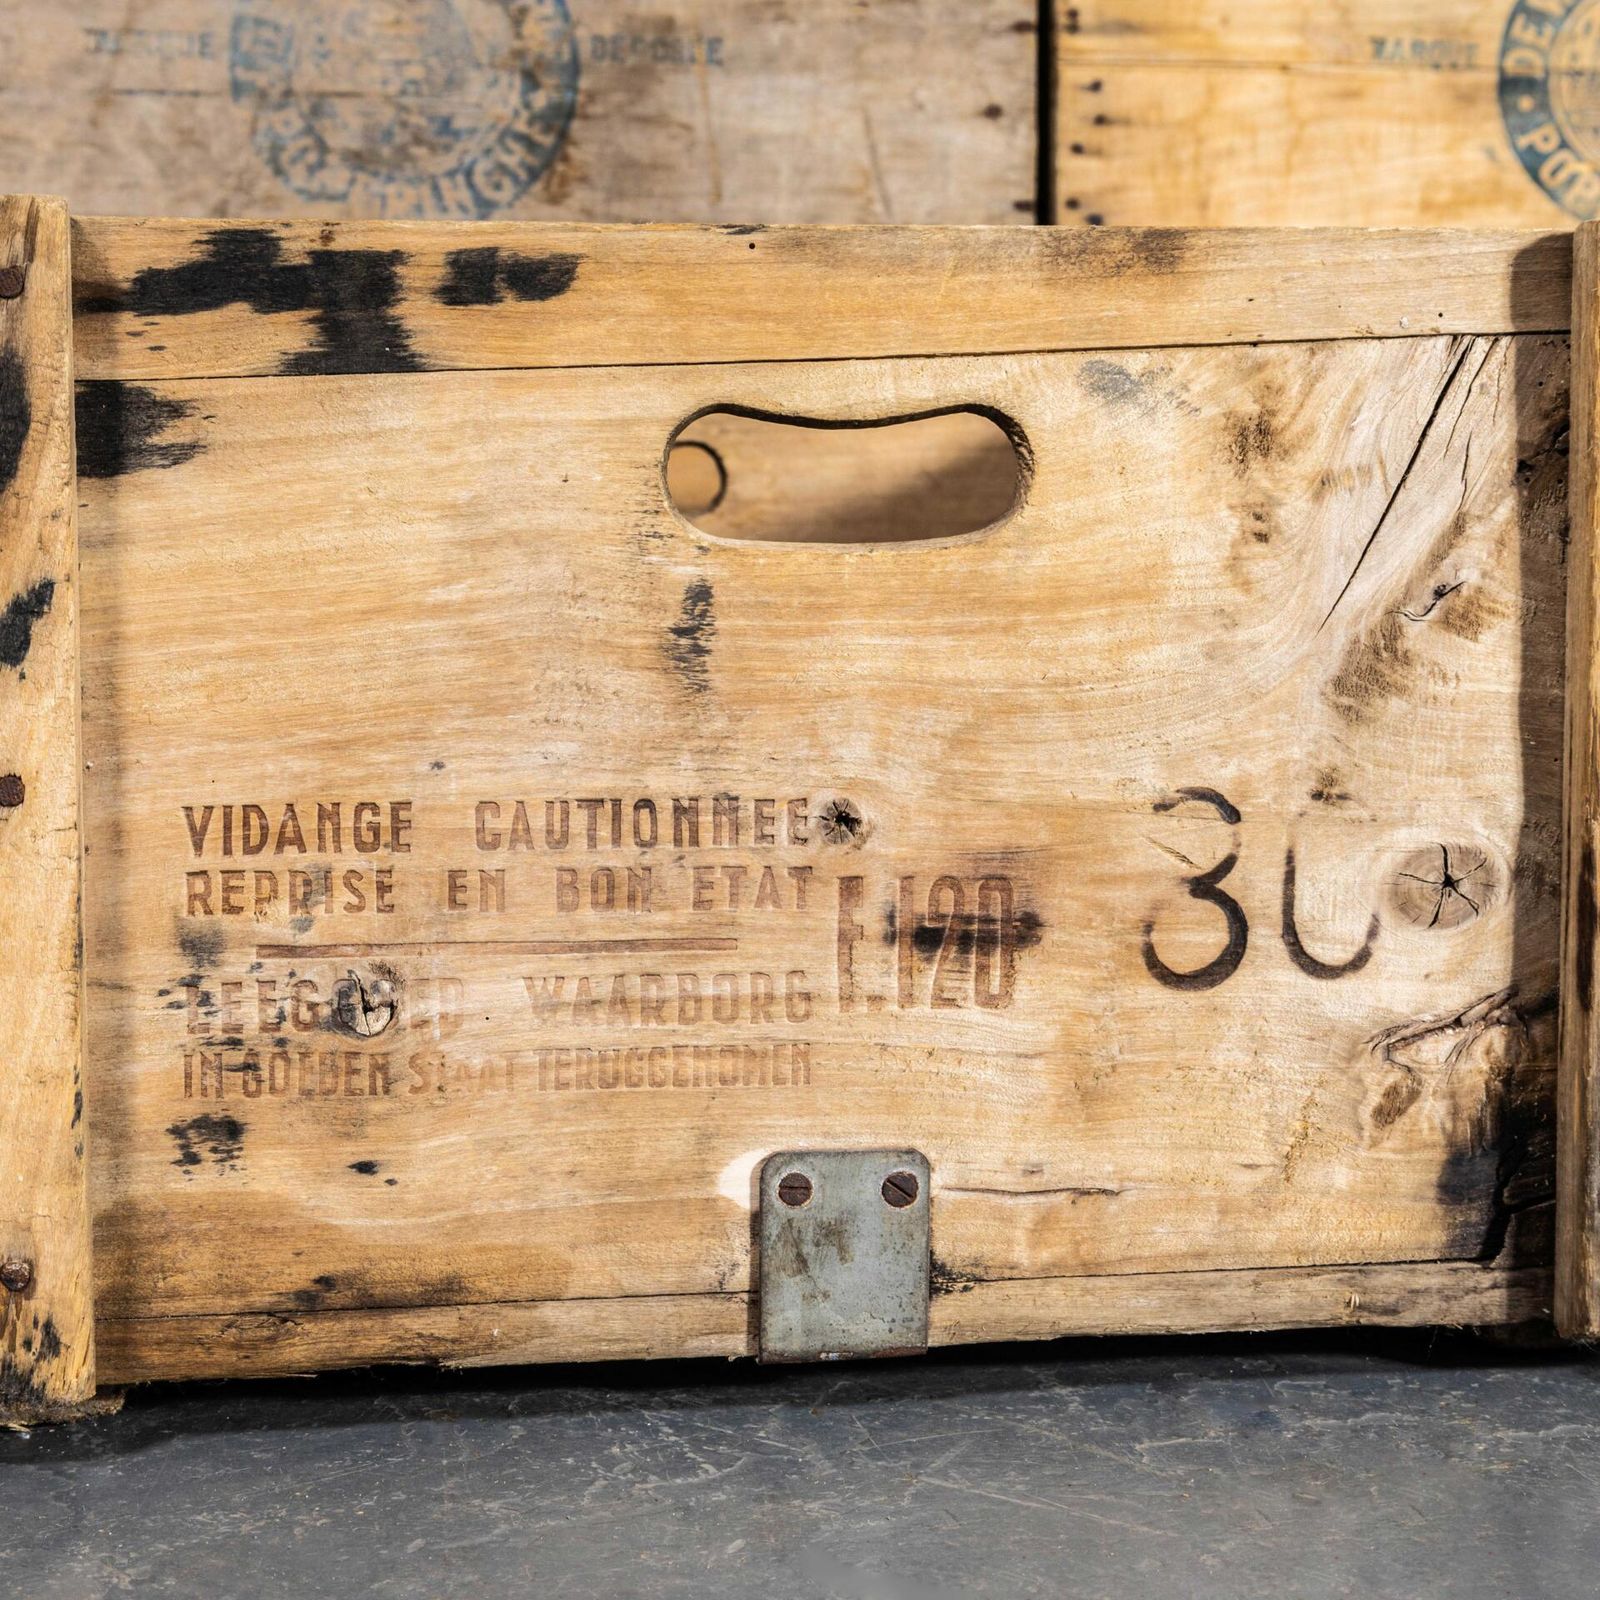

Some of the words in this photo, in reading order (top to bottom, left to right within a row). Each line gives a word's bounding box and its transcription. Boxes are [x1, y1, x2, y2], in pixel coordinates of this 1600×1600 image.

[180, 800, 413, 858] VIDANGE
[474, 797, 809, 852] CAUTIONNEE
[184, 868, 396, 918] REPRISE
[446, 867, 506, 914] EN
[555, 865, 653, 914] BON
[691, 864, 814, 913] ETAT
[521, 969, 813, 1029] WAARBORG
[183, 1051, 224, 1100] IN
